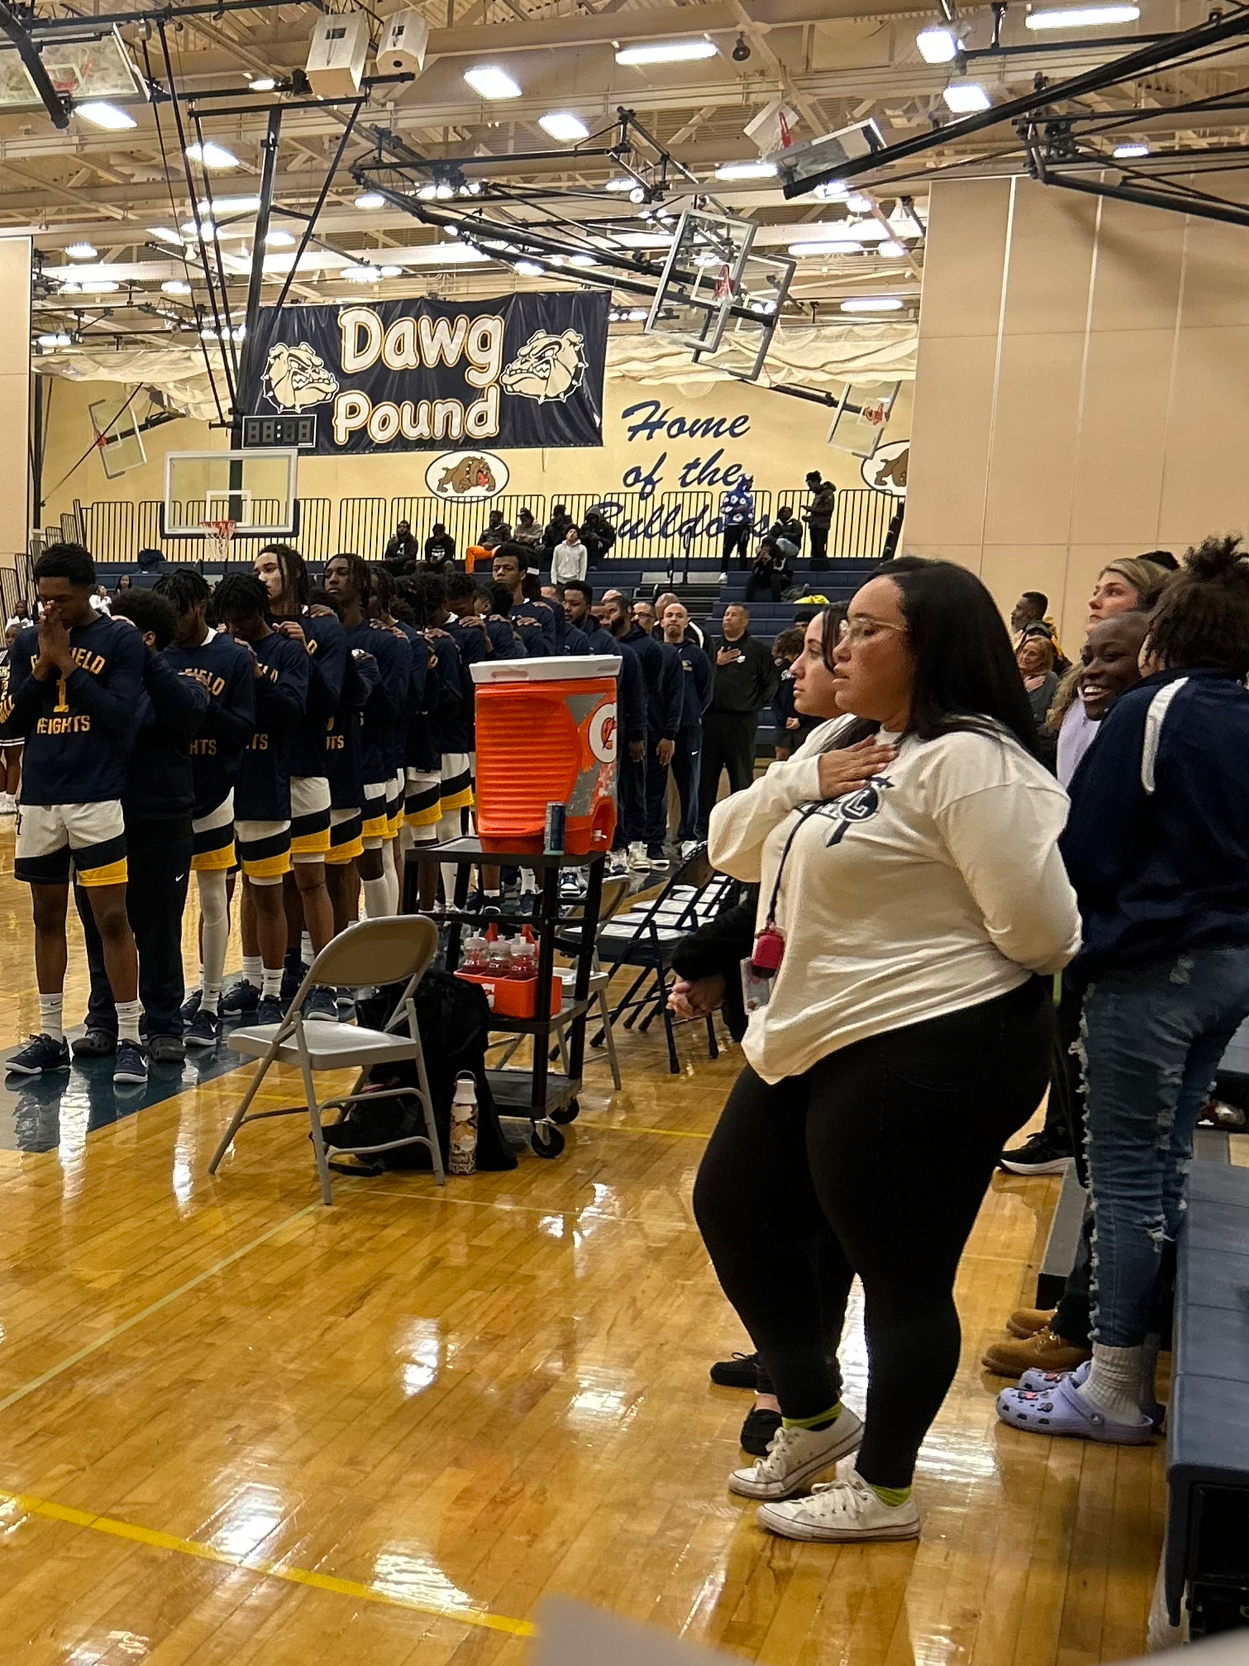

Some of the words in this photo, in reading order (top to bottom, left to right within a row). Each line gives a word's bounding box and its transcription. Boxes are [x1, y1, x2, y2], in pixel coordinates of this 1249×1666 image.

[338, 306, 504, 388] Dawg
[333, 384, 500, 446] Pound
[621, 400, 750, 442] Home
[623, 451, 668, 500] of
[679, 448, 743, 487] the
[53, 680, 69, 713] 1
